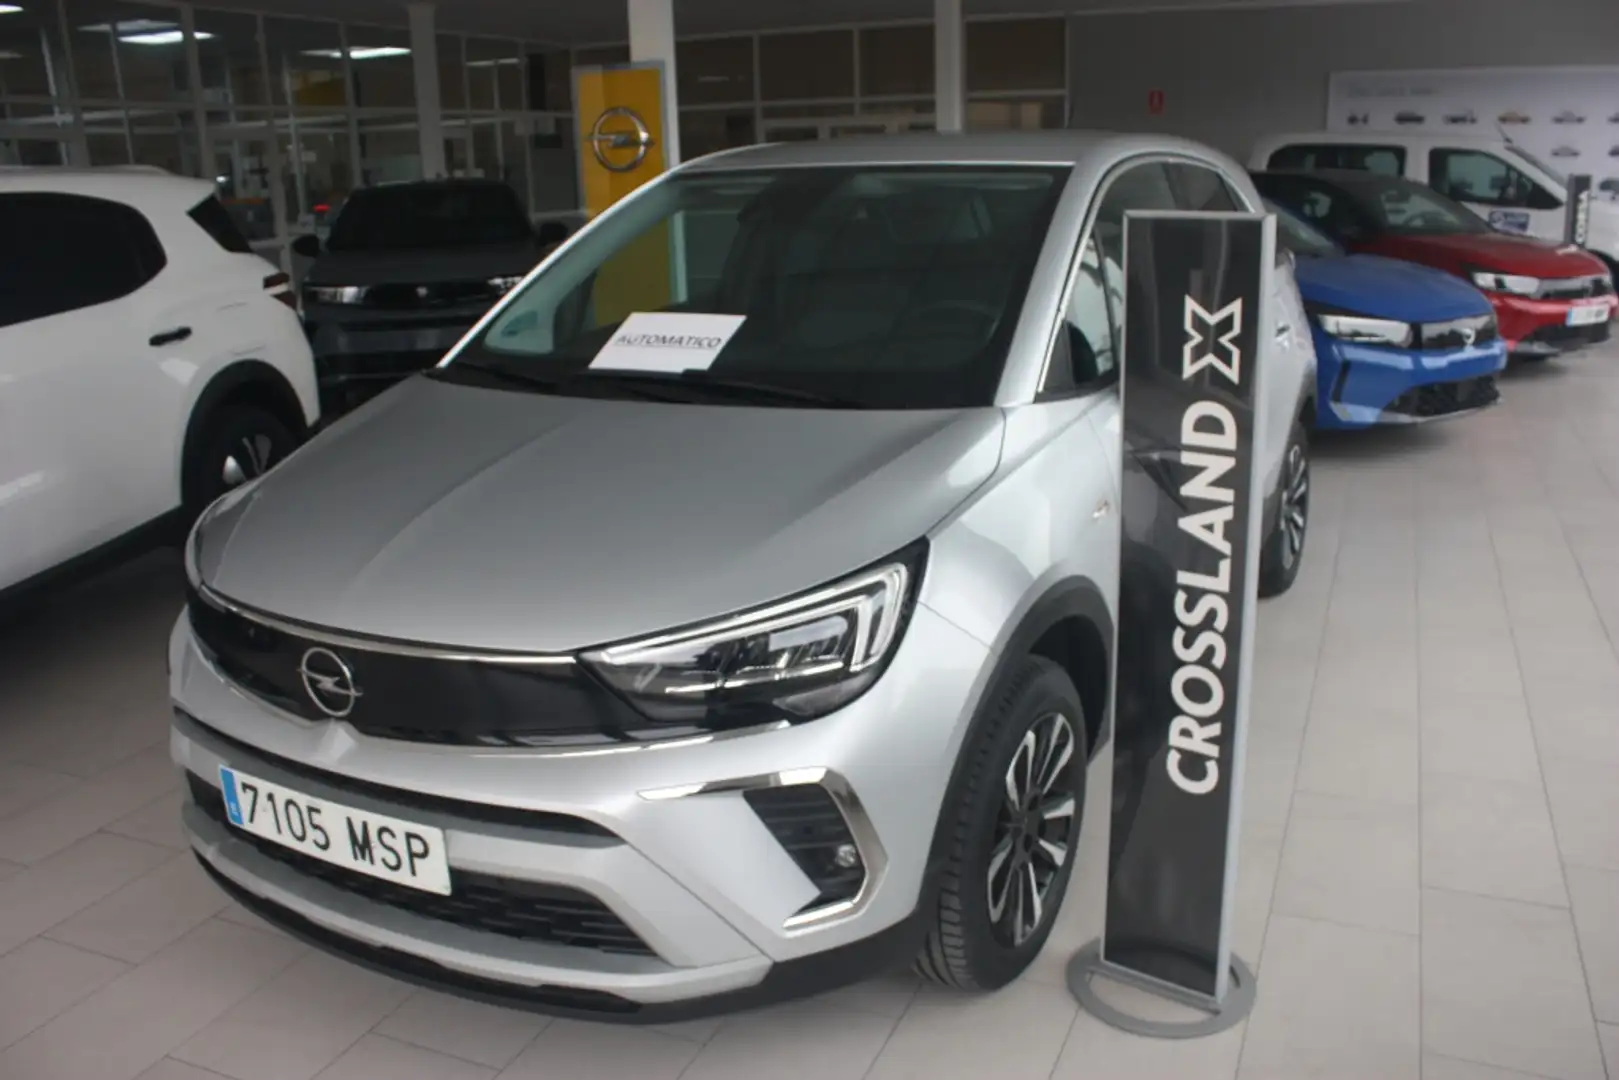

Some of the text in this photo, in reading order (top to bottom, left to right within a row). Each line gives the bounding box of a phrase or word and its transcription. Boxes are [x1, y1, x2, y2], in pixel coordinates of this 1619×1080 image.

[615, 333, 722, 349] AUTOMATICO
[1166, 294, 1242, 795] CROSSLAND X
[241, 781, 430, 877] 7105 MSP
